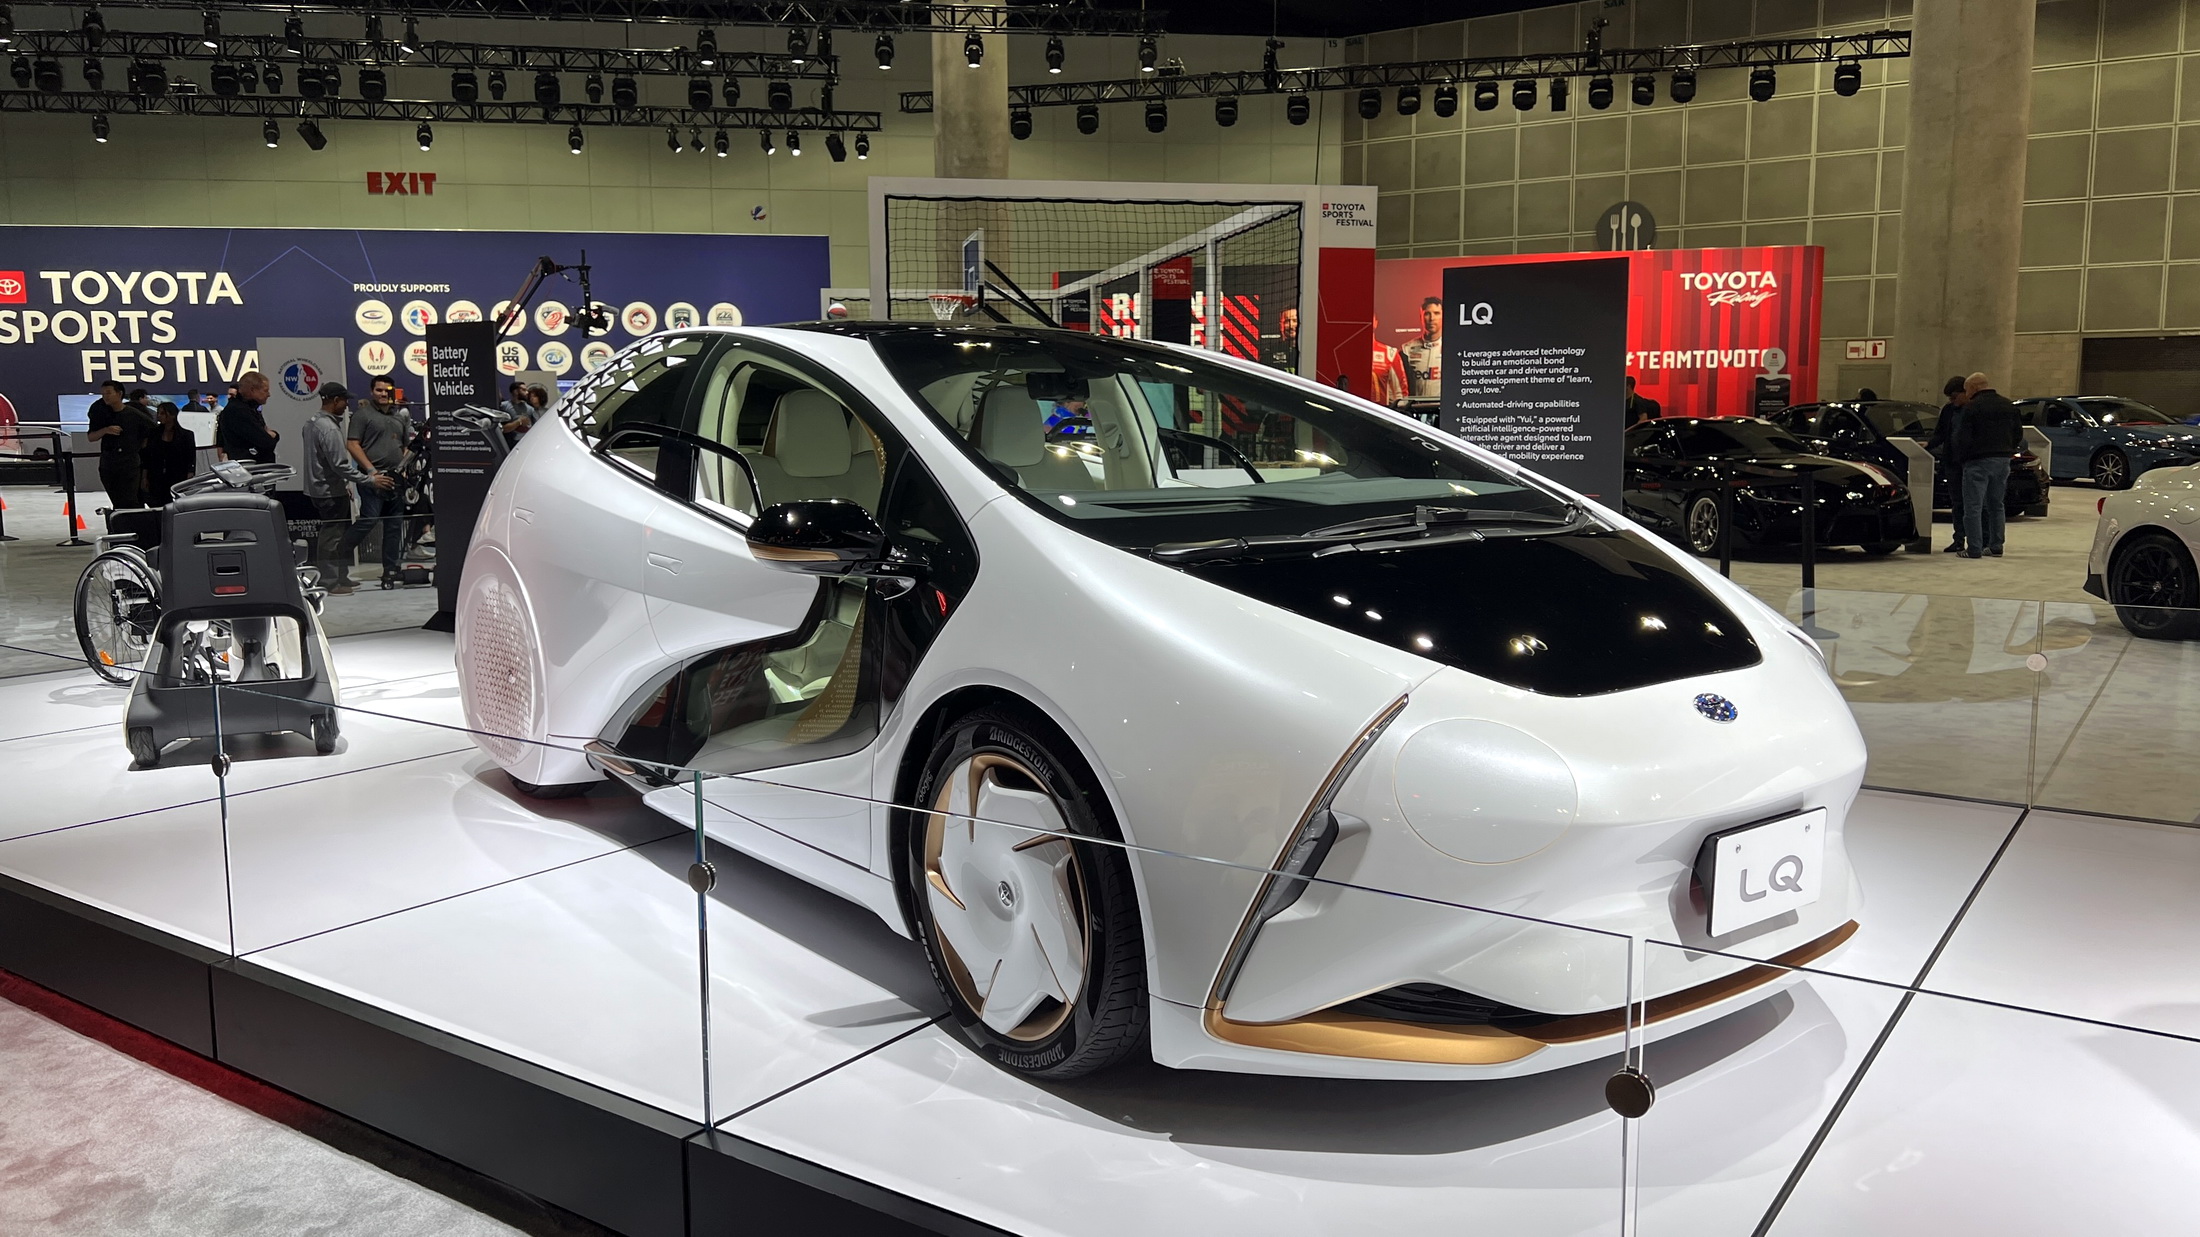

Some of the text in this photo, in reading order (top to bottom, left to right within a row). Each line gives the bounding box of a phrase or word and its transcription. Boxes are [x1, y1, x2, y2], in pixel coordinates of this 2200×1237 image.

[366, 171, 437, 196] EXIT
[1331, 203, 1366, 211] TOYOTA
[1336, 218, 1374, 226] FESTIVAL
[1679, 271, 1778, 290] TOYOTA
[40, 270, 244, 305] TOYOTA
[354, 283, 451, 293] PROUDLY SUPPORTS
[1706, 289, 1778, 308] Racing
[1459, 302, 1494, 326] LQ
[0, 310, 177, 344] SPORTS
[432, 346, 468, 362] Battery
[502, 346, 519, 355] US
[1463, 347, 1586, 358] Leverages advanced technology
[81, 349, 260, 383] FESTIVA
[1503, 357, 1542, 366] emotional
[433, 364, 470, 378] Electric
[1508, 367, 1524, 375] and
[1525, 366, 1548, 374] driver
[1479, 377, 1529, 386] development
[1566, 375, 1593, 384] "learn,
[434, 382, 474, 396] Vehicles
[1484, 386, 1505, 394] love."
[1462, 400, 1580, 410] Automated-driving capabilities
[1462, 416, 1498, 425] Equipped
[1517, 416, 1537, 424] "Yui,"
[1545, 415, 1580, 424] powerful
[1491, 425, 1574, 434] intelligence-powered
[1524, 434, 1560, 443] designed
[1509, 452, 1540, 461] mobility
[1541, 453, 1584, 461] experience
[989, 726, 1055, 782] BRIDGESTONE
[1740, 854, 1803, 903] LQ
[998, 1042, 1065, 1069] BRIDGESTONE
